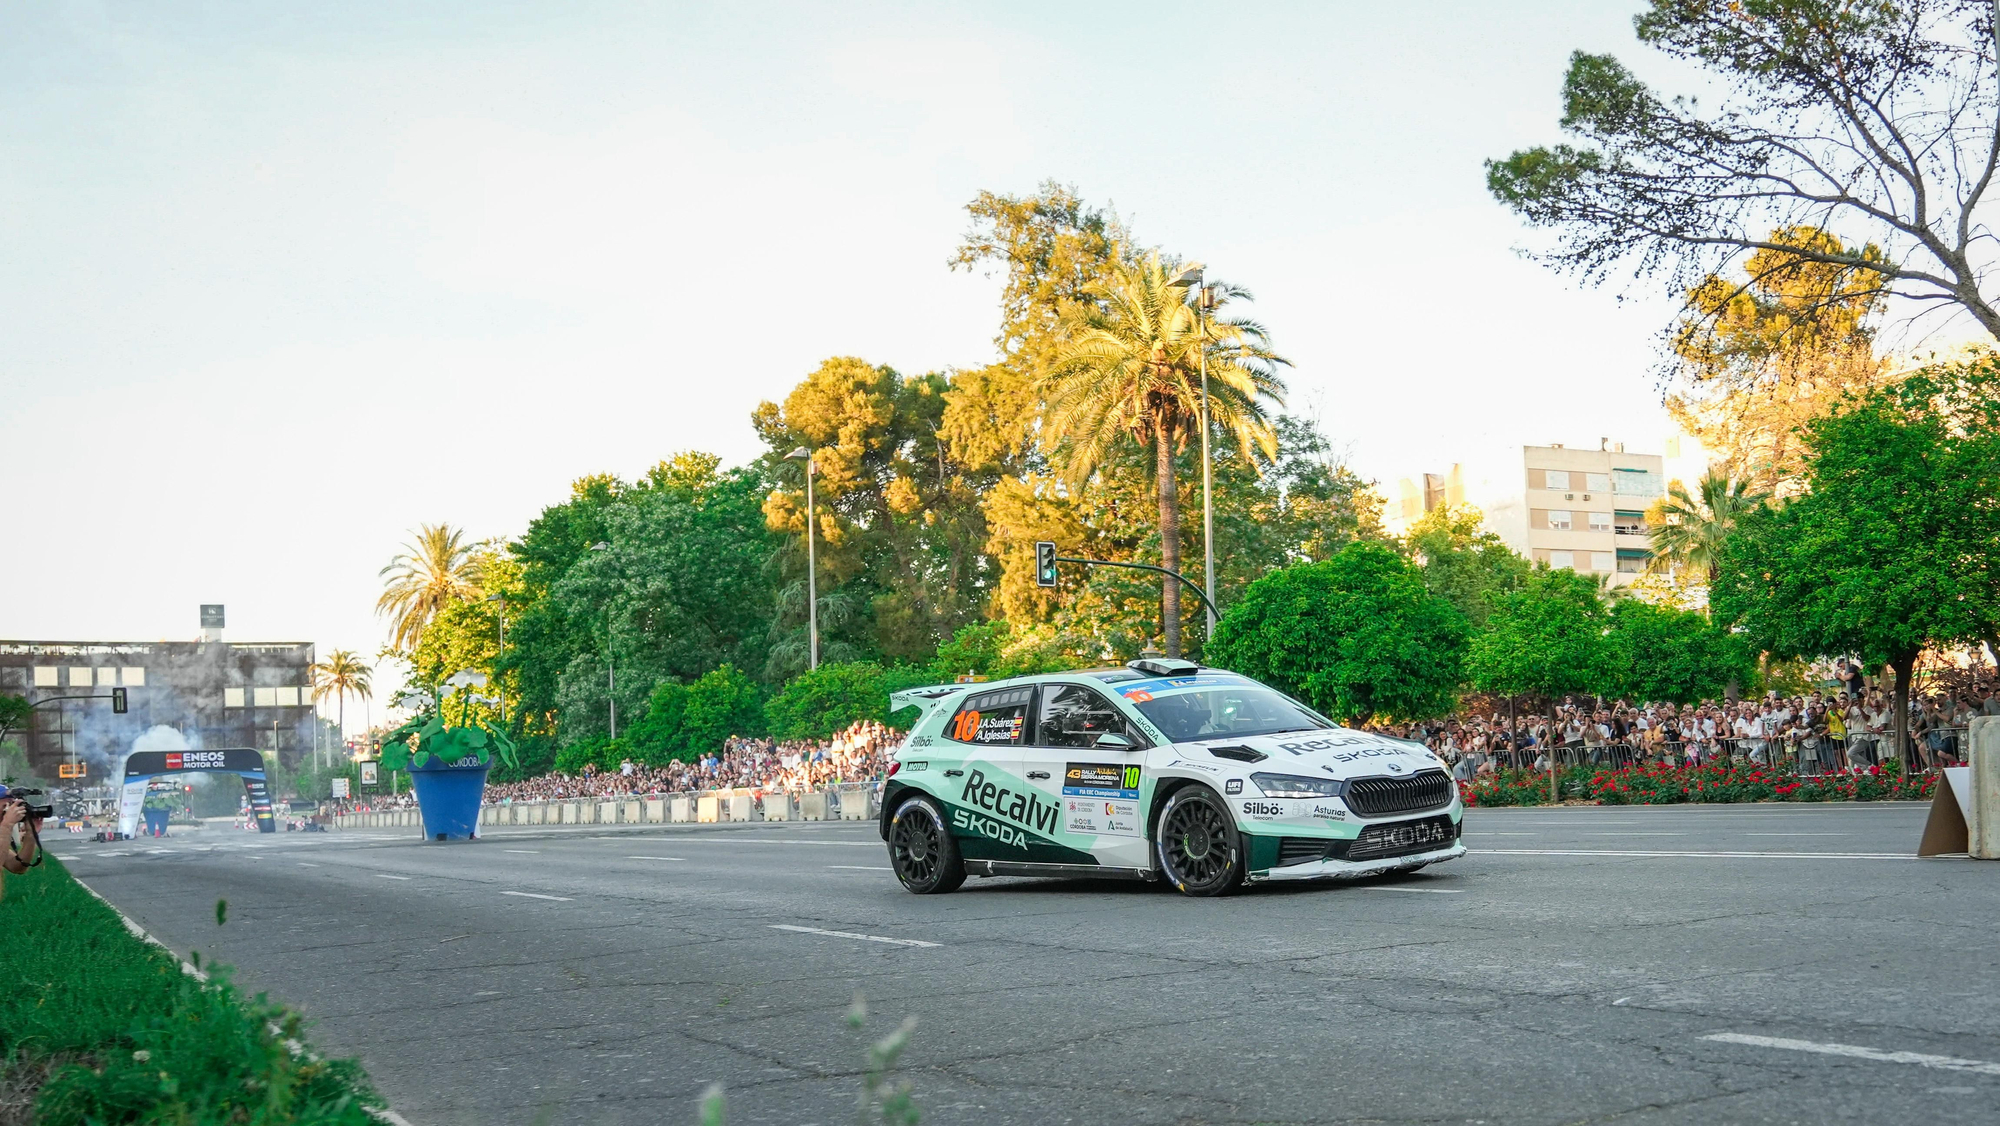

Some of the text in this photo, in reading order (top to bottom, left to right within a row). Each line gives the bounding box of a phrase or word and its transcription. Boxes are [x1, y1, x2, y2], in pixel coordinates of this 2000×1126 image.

[1123, 690, 1154, 704] 10
[954, 710, 980, 742] 10
[1135, 716, 1159, 741] SKODA
[183, 752, 225, 762] ENEOS
[907, 762, 928, 770] MOTUL
[1067, 769, 1081, 779] 43
[1124, 767, 1140, 788] 10
[961, 769, 1060, 836] Recalvi
[1243, 802, 1283, 815] Silbö:
[1314, 804, 1346, 817] Asturias
[953, 809, 1028, 851] SKODA
[1366, 823, 1444, 850] SKODA
